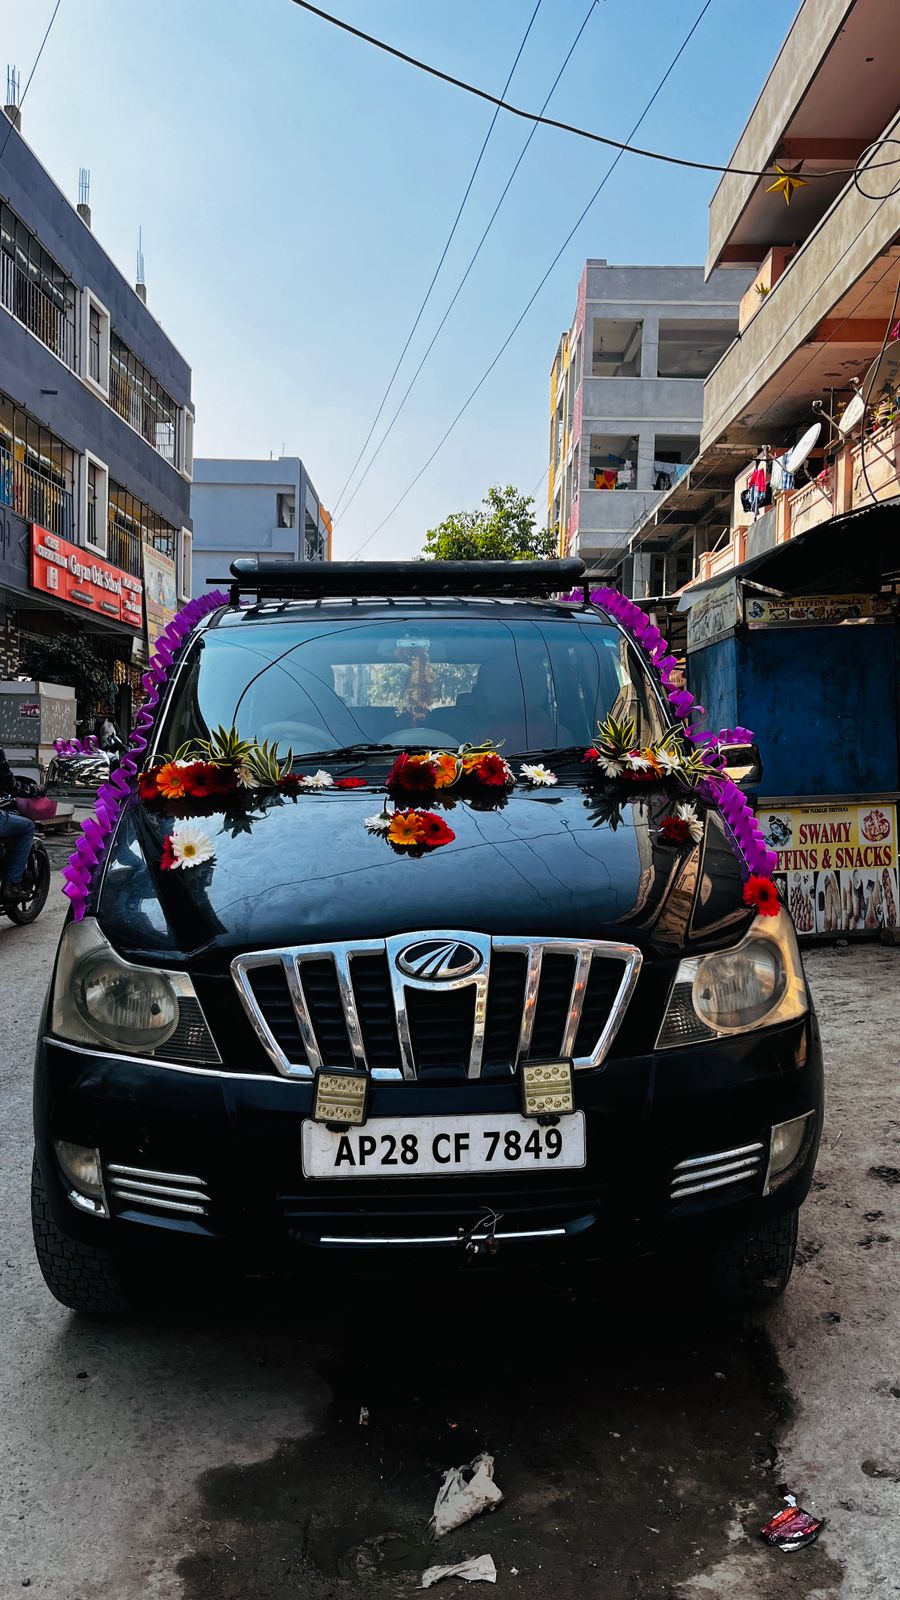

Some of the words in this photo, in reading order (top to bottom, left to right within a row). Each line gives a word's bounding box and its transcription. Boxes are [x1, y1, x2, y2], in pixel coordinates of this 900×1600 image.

[799, 822, 852, 845] SWAMY
[775, 848, 818, 871] FFINS
[821, 848, 832, 870] &
[835, 845, 893, 868] SNACKS
[334, 1133, 419, 1167] AP28
[432, 1132, 470, 1164] CF
[483, 1128, 563, 1162] 7849
